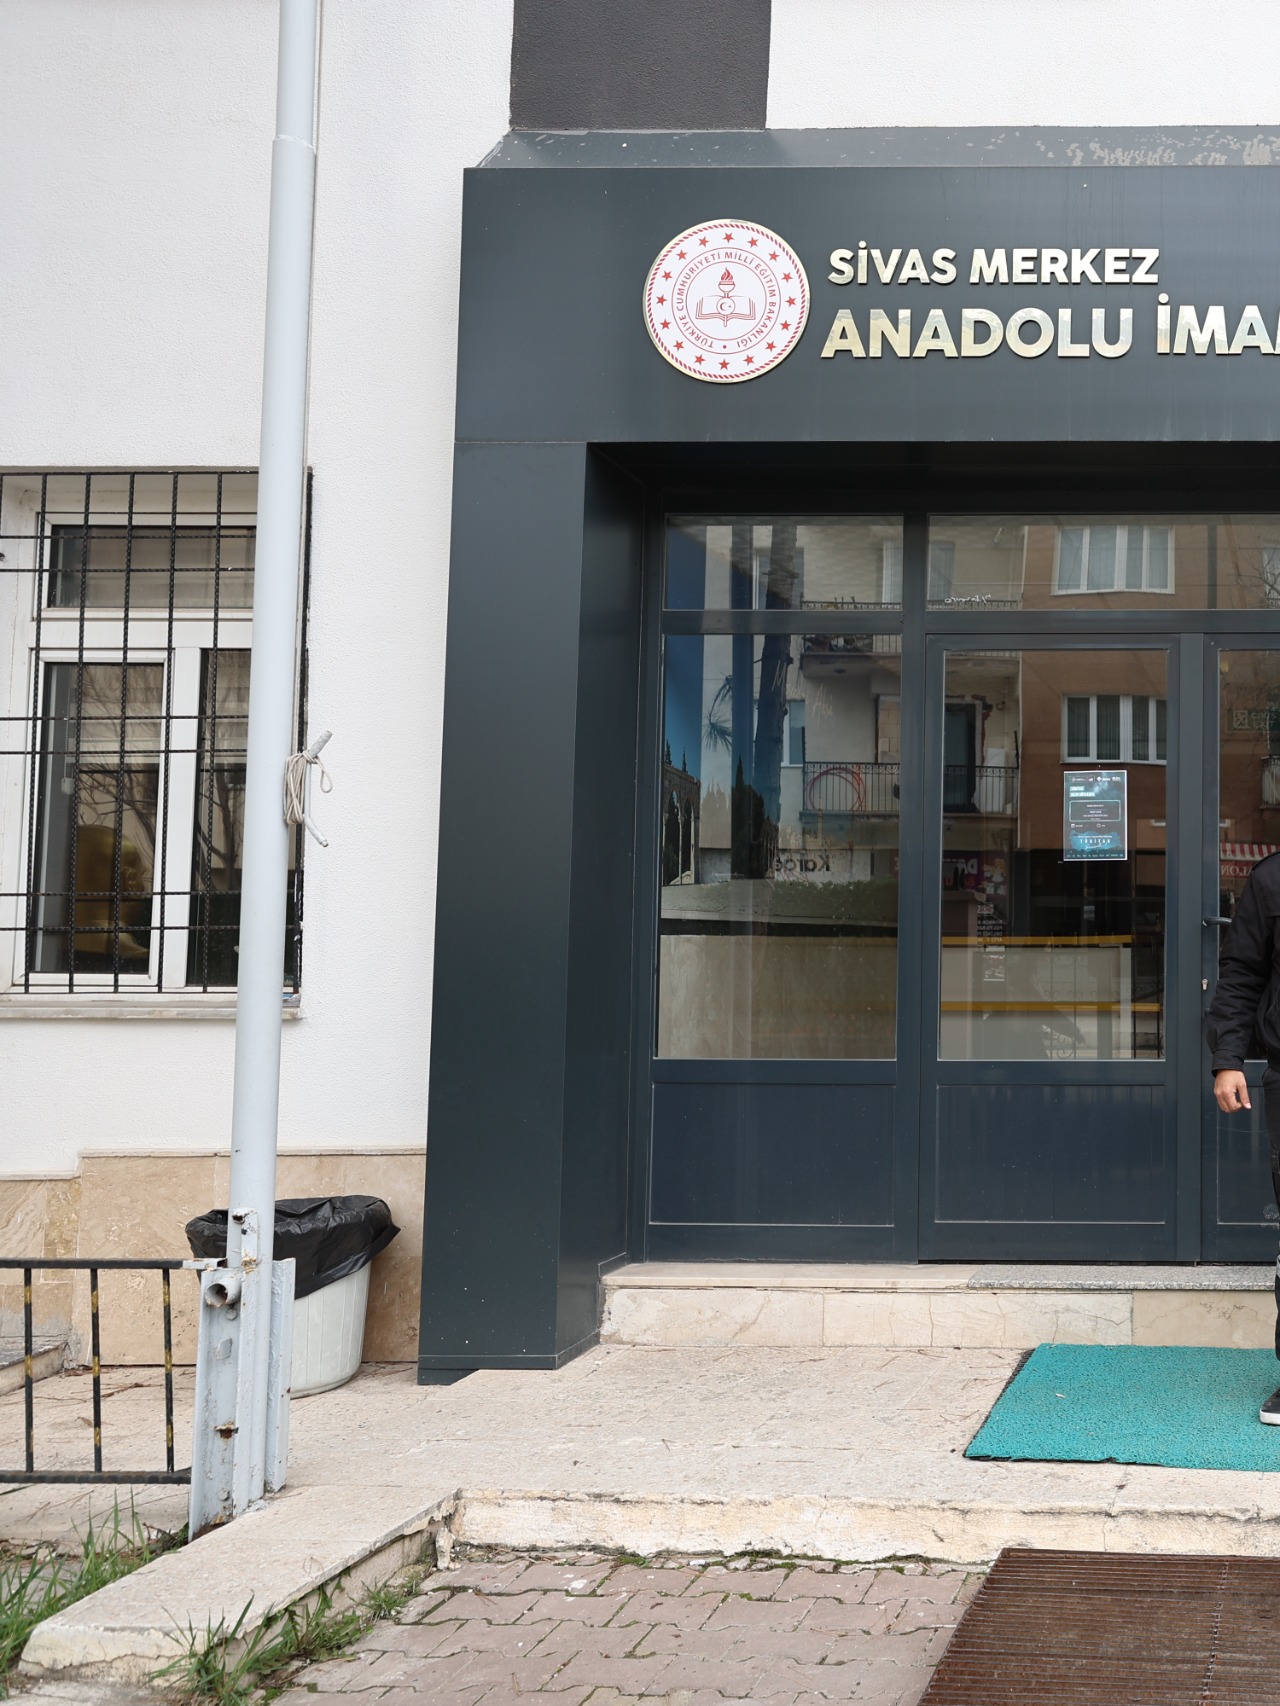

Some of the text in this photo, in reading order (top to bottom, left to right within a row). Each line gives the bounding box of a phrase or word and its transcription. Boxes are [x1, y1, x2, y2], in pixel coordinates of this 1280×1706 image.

[827, 240, 1160, 285] SİVAS MERKEZ
[676, 251, 777, 348] TÜRKİYE CUMHURİYETİ MİLLİ EĞİTİM BAKANLIĞI
[820, 307, 1133, 358] ANADOLU
